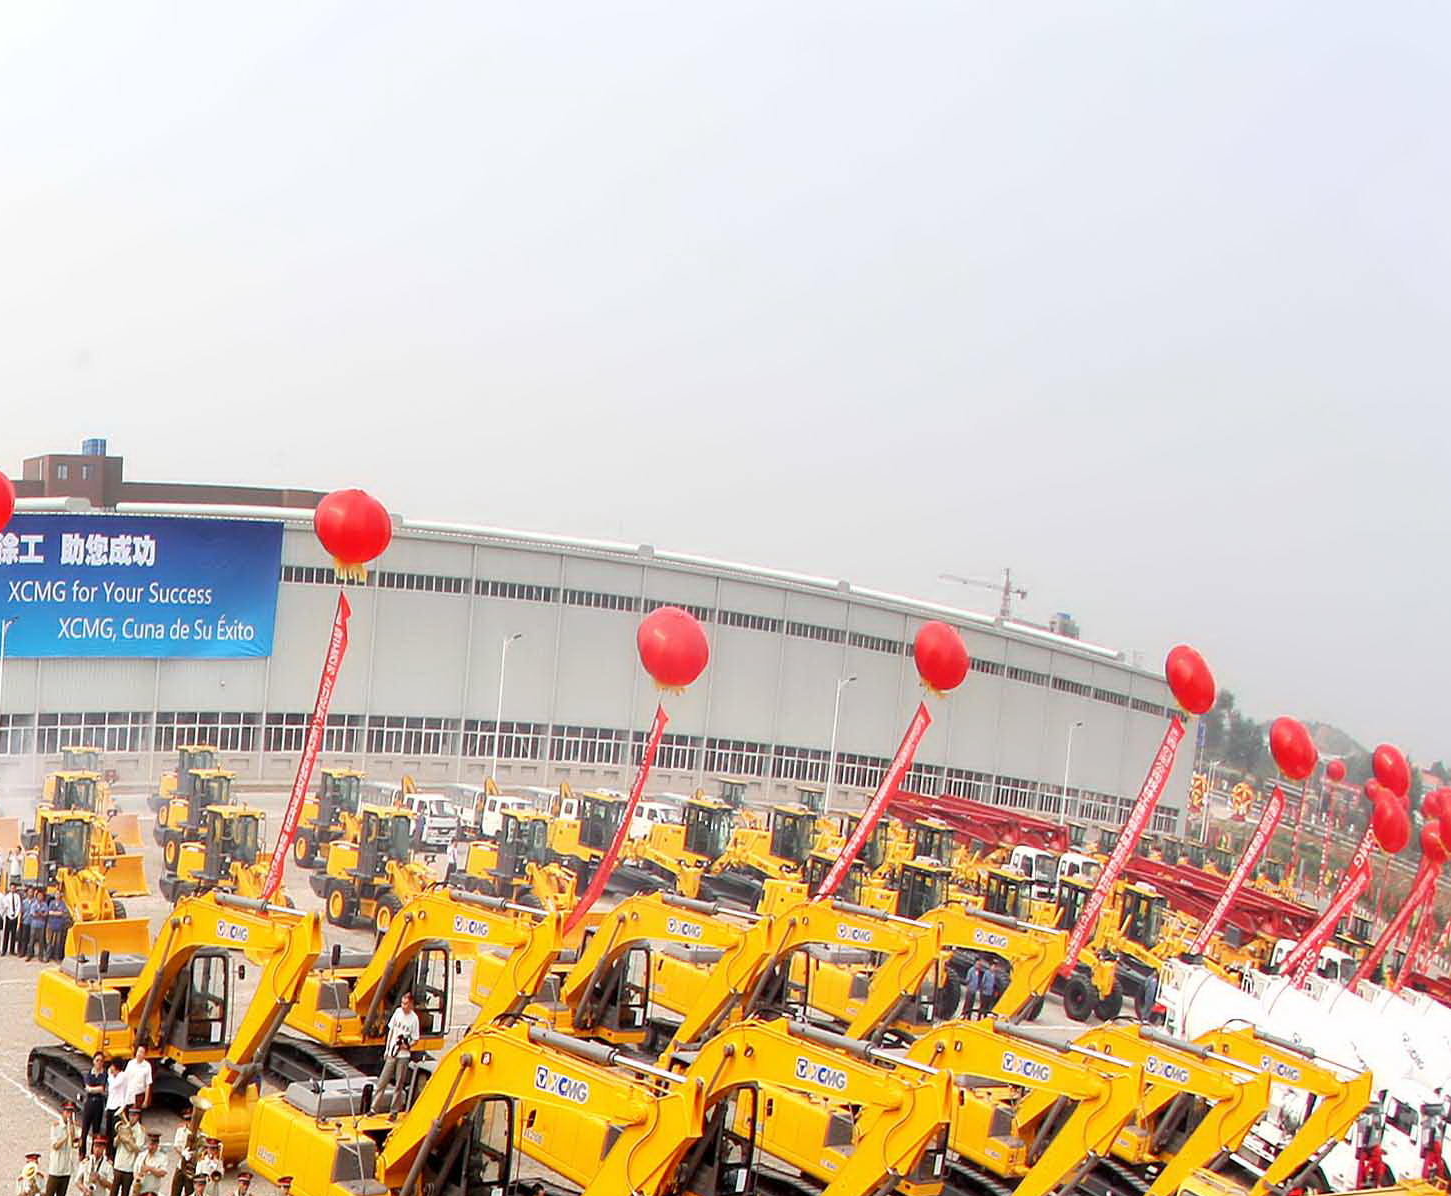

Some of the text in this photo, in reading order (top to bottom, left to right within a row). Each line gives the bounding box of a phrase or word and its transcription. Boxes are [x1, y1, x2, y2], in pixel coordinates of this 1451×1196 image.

[60, 533, 156, 566] 助您成功
[8, 580, 213, 605] XCMG for Your Success
[57, 614, 255, 641] XCMG, Cuna de Su Éxito
[548, 1073, 588, 1103] XCMG
[808, 1062, 846, 1090] XCMG
